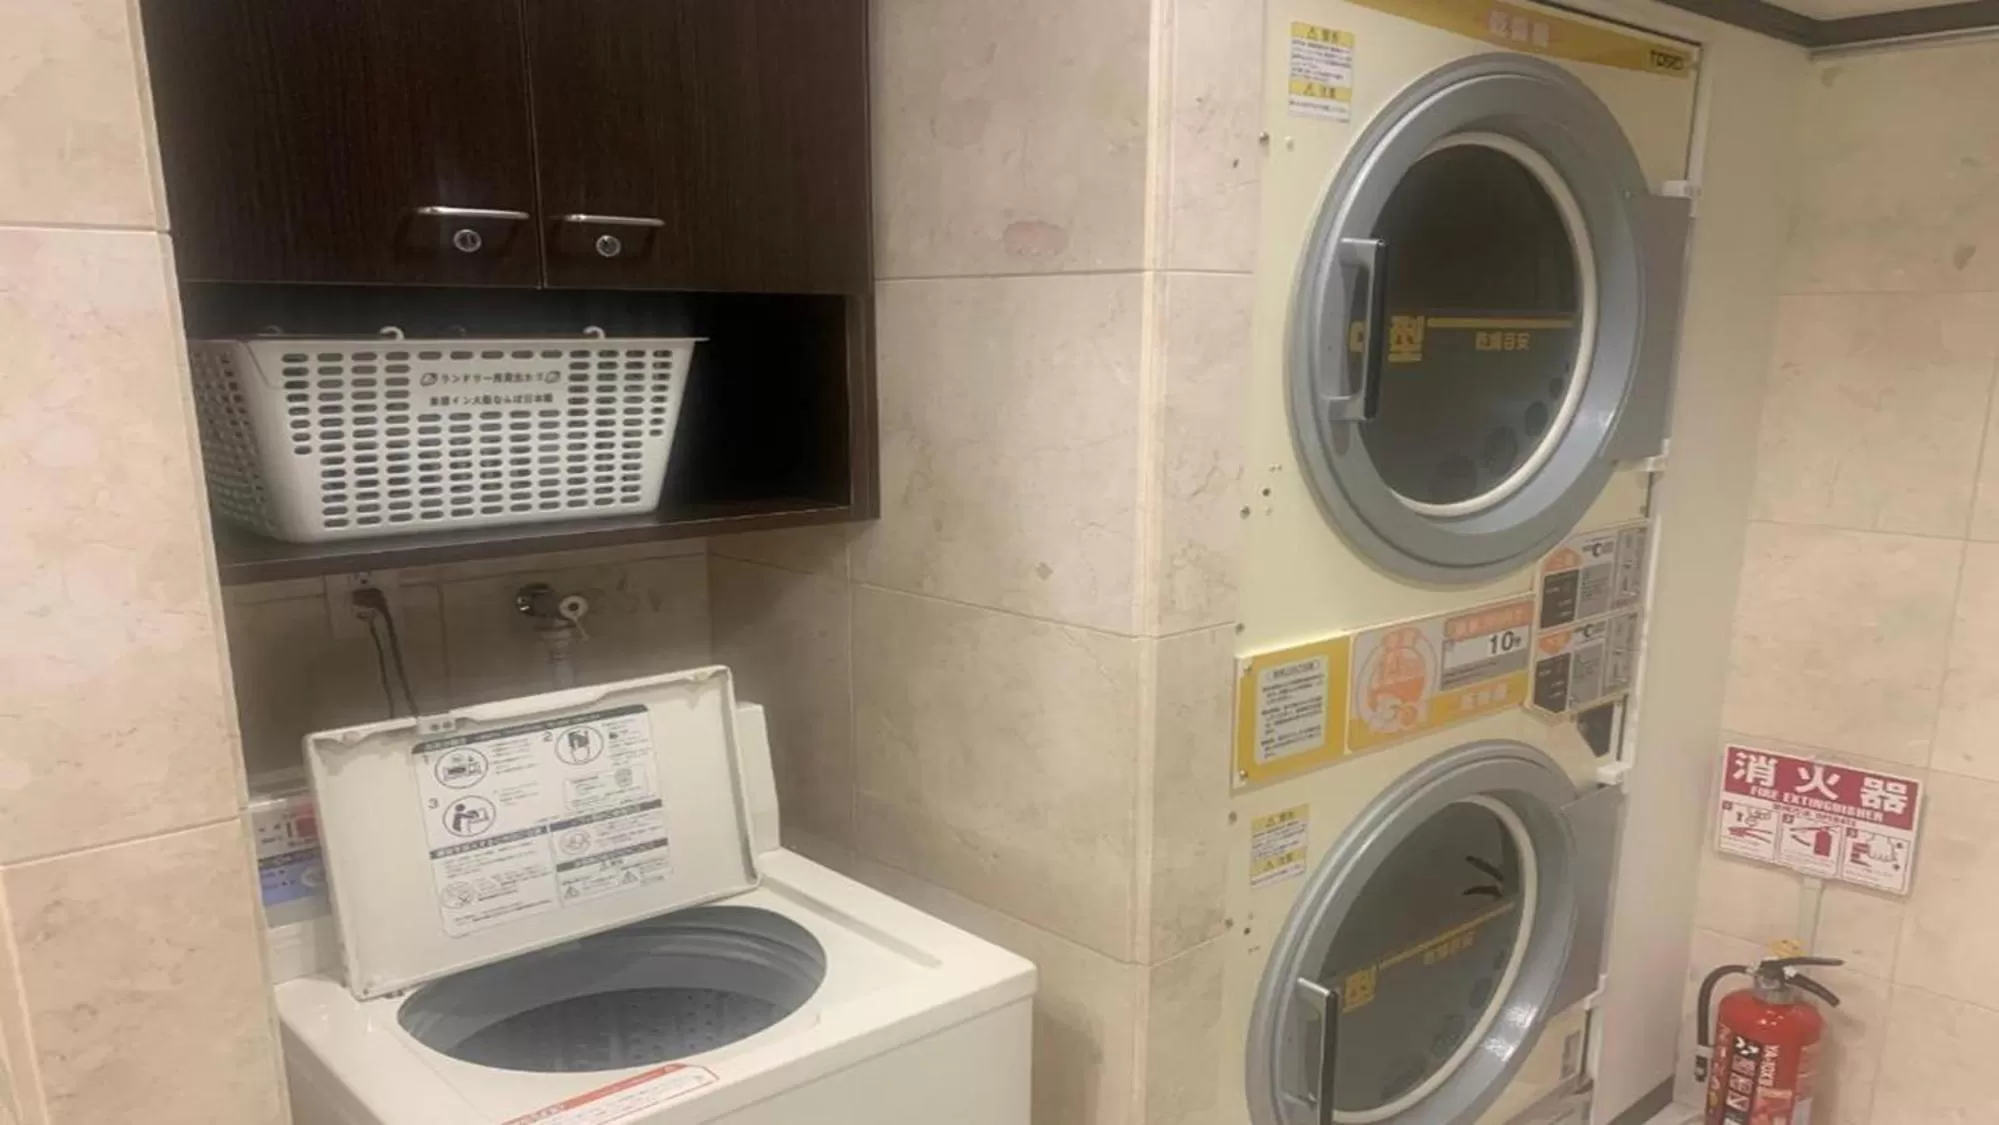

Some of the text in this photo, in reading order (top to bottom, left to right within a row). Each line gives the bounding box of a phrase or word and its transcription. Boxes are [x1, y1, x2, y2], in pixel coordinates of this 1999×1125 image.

[1732, 751, 1909, 815] 消火器
[1751, 786, 1884, 822] FIRE EXTINGUISHER
